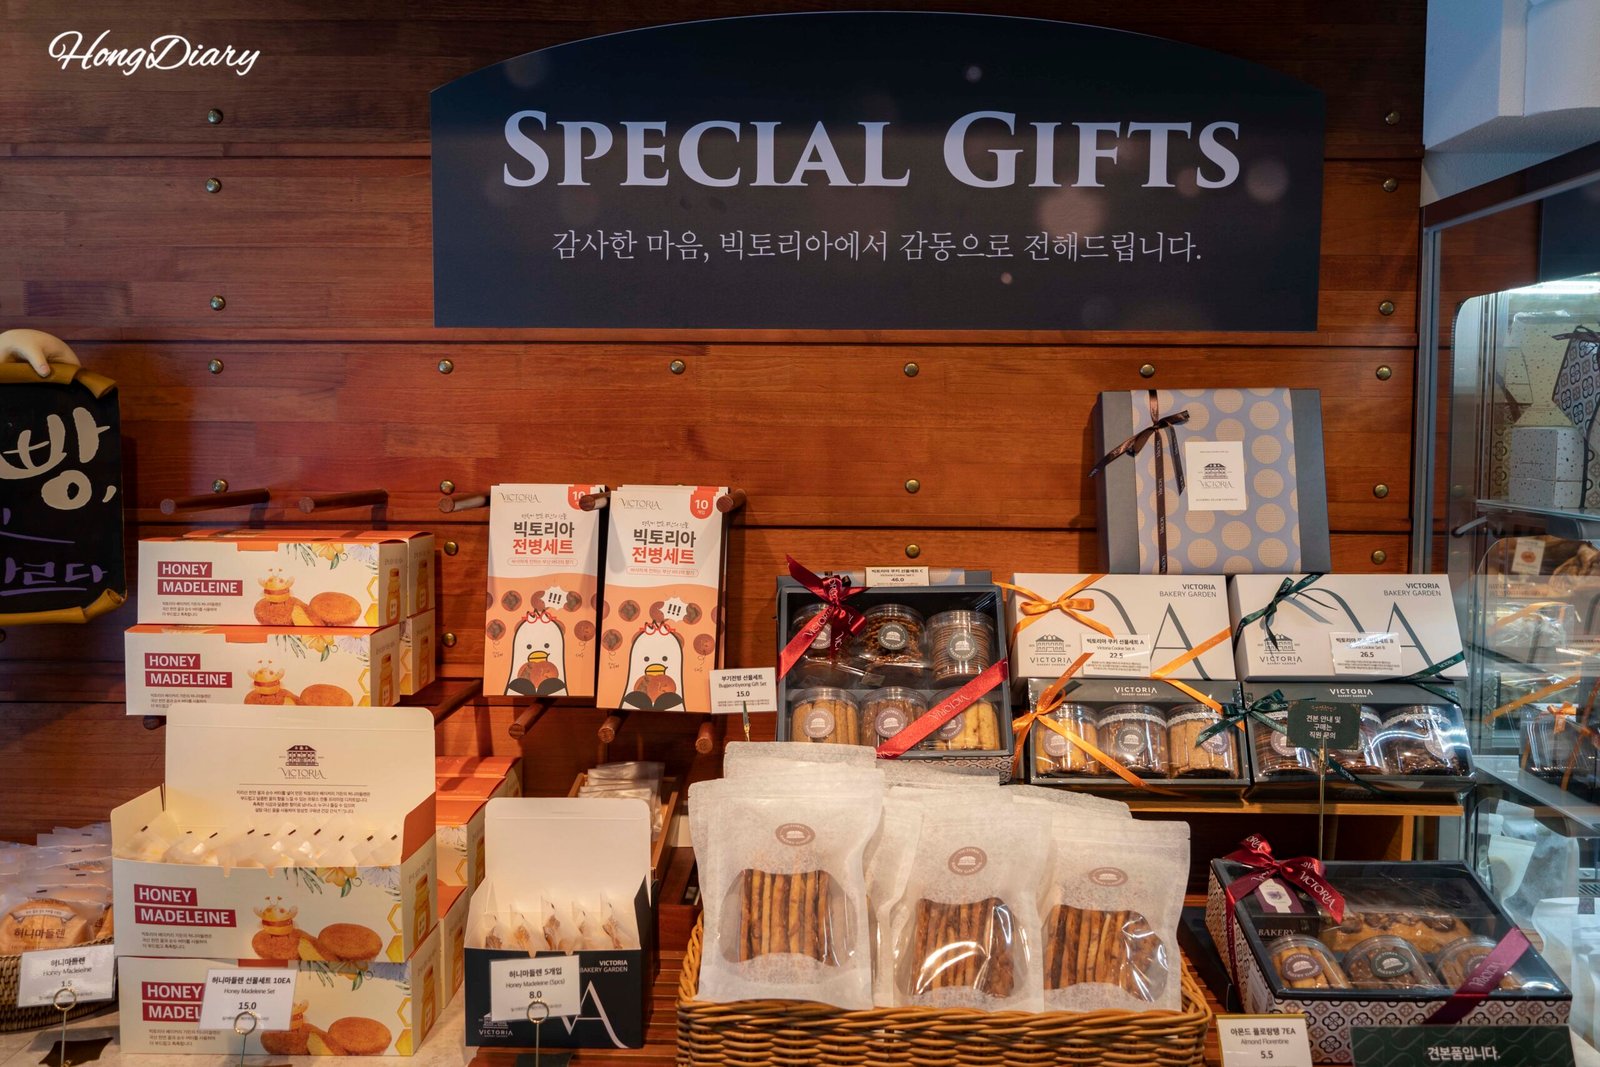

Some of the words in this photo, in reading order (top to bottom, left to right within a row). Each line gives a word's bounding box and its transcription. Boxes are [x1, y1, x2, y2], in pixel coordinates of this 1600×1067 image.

[502, 110, 910, 188] SPECIAL
[943, 110, 1241, 189] GIFTS
[552, 229, 637, 261] 감사한
[647, 229, 710, 262] 마음,
[721, 229, 888, 262] 빅토리아에서
[900, 230, 1014, 262] 감동으로
[1023, 230, 1202, 263] 전해드립니다.
[500, 492, 541, 503] VICTORIA
[620, 498, 663, 510] VICTORIA
[695, 499, 709, 510] 10
[513, 521, 575, 538] 빅토리아
[633, 528, 697, 548] 빅토리아
[513, 538, 575, 556] 전병세트
[632, 546, 695, 565] 전병세트
[162, 563, 208, 576] HONEY
[162, 581, 238, 594] MADELEINE
[1412, 589, 1441, 597] GARDEN
[1188, 590, 1217, 598] GARDEN
[150, 655, 196, 667] HONEY
[150, 672, 228, 686] MADELEINE
[1114, 686, 1157, 694] VICTORIA
[1306, 715, 1318, 723] 견본
[1320, 715, 1333, 724] 안내
[1334, 716, 1341, 724] 및
[1313, 723, 1332, 731] 구매는
[1309, 731, 1322, 739] 직원
[1323, 731, 1336, 740] 문의
[278, 767, 327, 779] VICTORIA
[139, 887, 192, 903] HONEY
[1300, 870, 1336, 911] VICTORIA
[140, 908, 230, 924] MADELEINE
[14, 928, 66, 939] 허니마들렌
[1258, 929, 1296, 937] BAKERY
[51, 957, 86, 966] 허니마들렌
[63, 967, 92, 975] Madeleine
[509, 968, 542, 978] 허니마들렌
[544, 966, 562, 975] 5개입
[212, 976, 244, 985] 허니마들렌
[245, 976, 271, 984] 선물세트
[147, 985, 202, 999] HONEY
[529, 990, 542, 999] 8.0
[238, 1001, 257, 1010] 15.0
[149, 1006, 200, 1020] MADEL
[1230, 1027, 1251, 1036] 아몬드
[1281, 1027, 1296, 1035] 7EA
[1260, 1050, 1273, 1059] 5.5
[1427, 1045, 1501, 1061] 견본품입니다.
